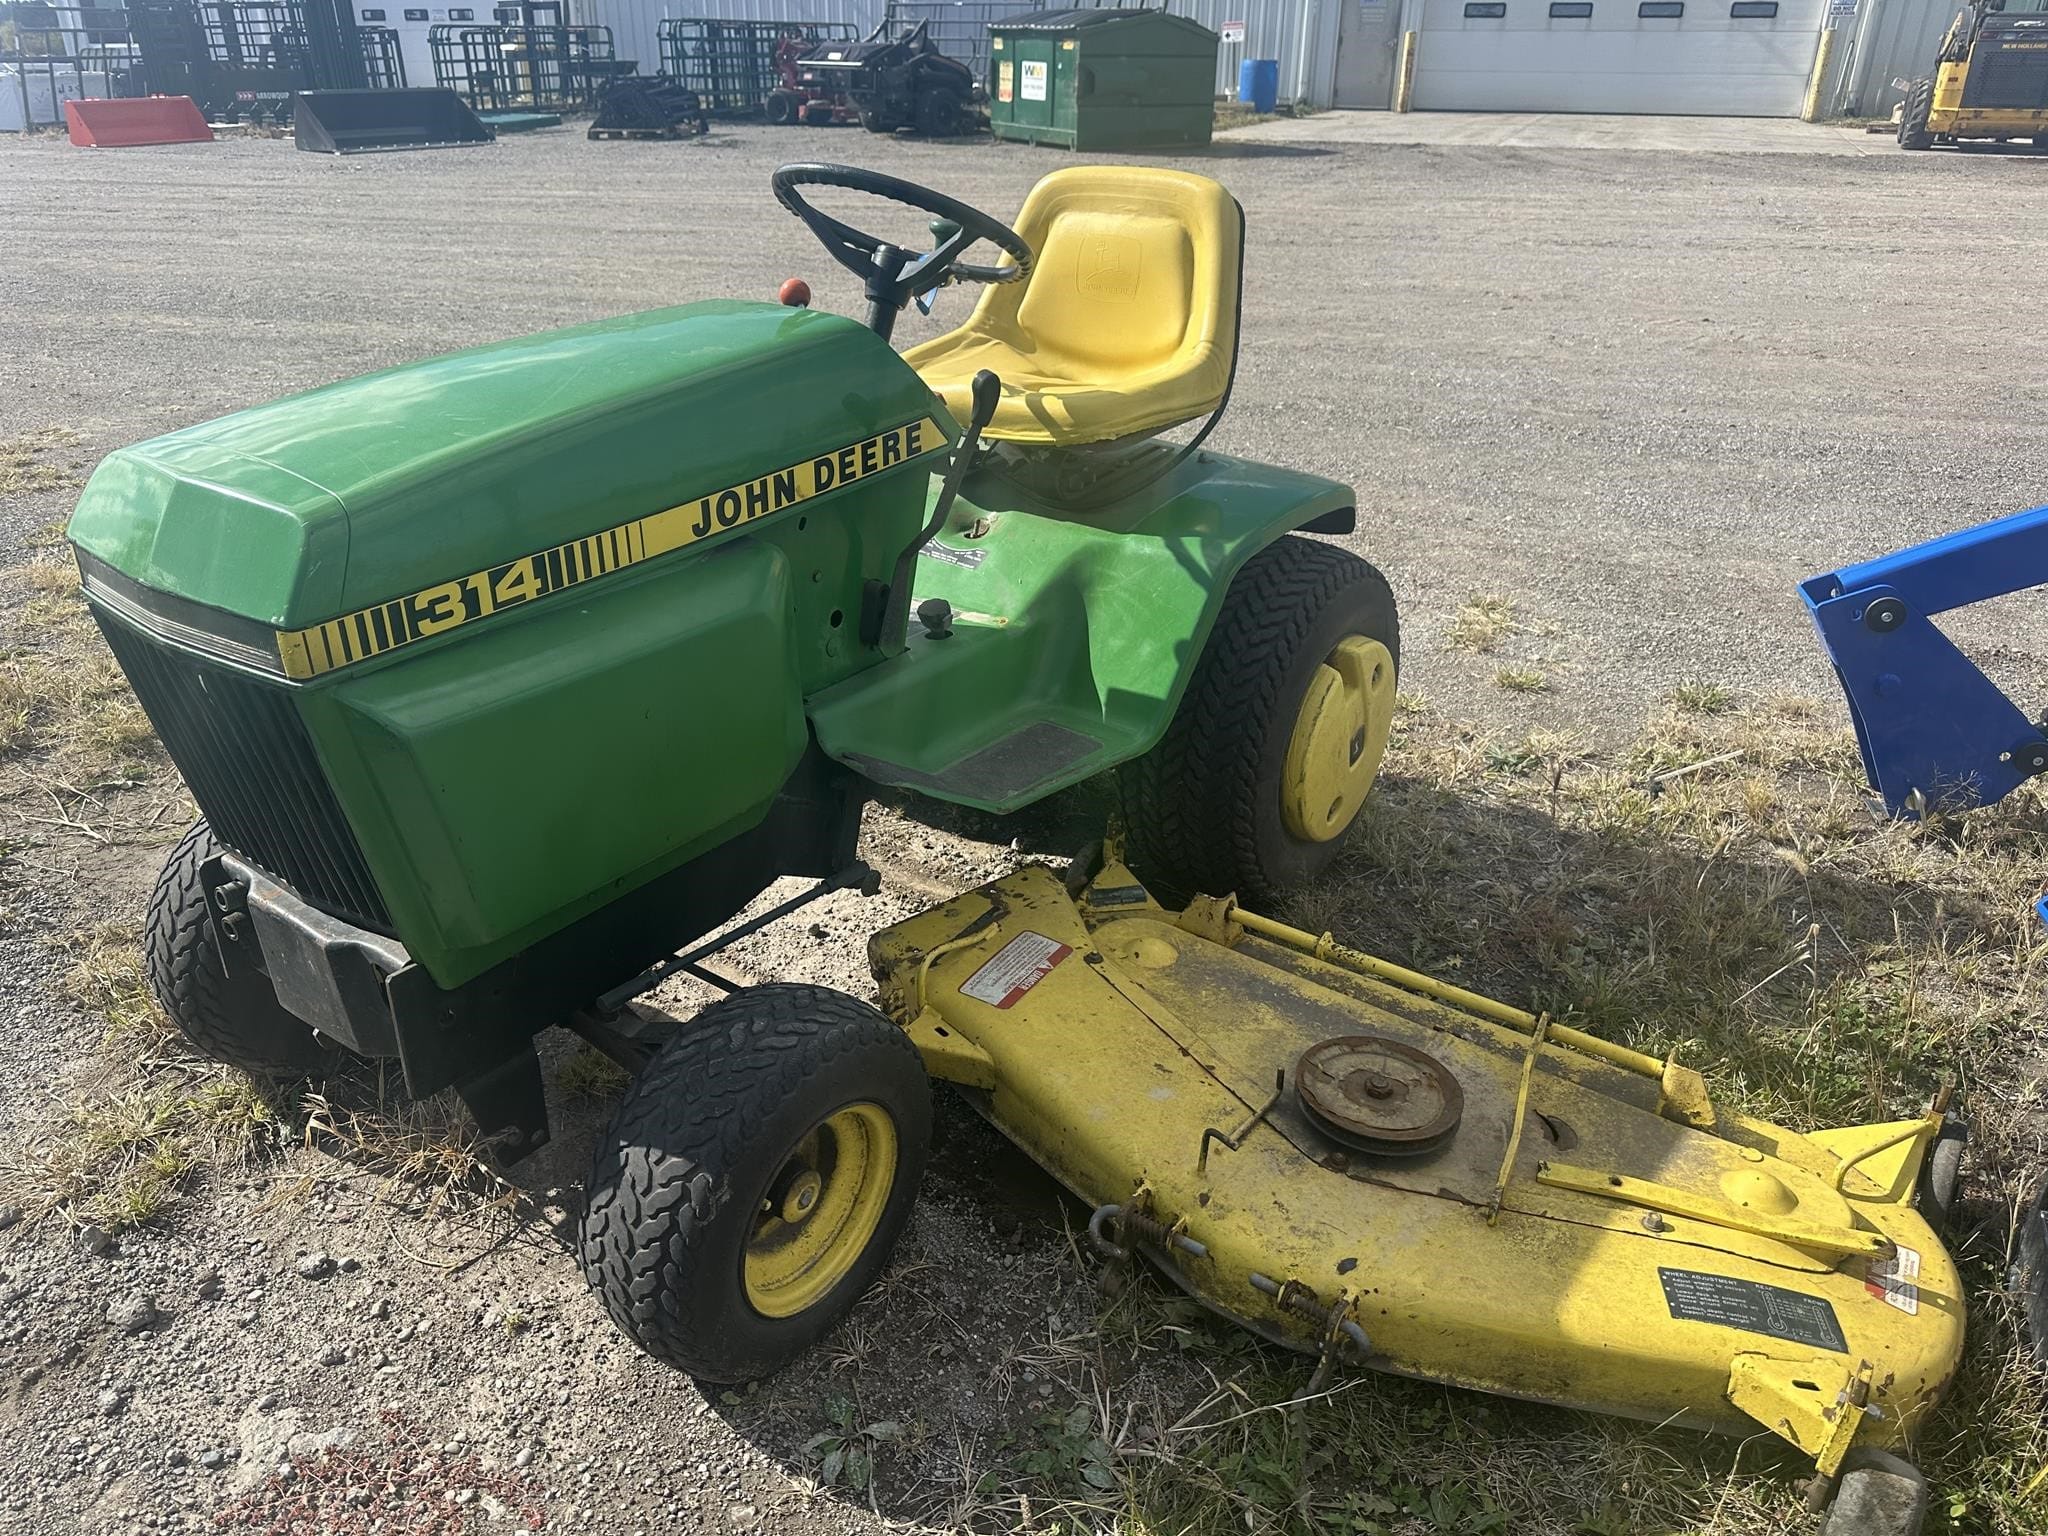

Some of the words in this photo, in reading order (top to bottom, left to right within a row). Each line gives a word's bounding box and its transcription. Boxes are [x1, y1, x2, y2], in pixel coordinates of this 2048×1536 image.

[1024, 65, 1043, 76] WM
[692, 469, 796, 537] JOHN
[814, 423, 922, 493] DEERE
[415, 557, 541, 636] 314
[1017, 969, 1045, 990] DANGER
[1691, 1274, 1737, 1286] ADJUSTMENT
